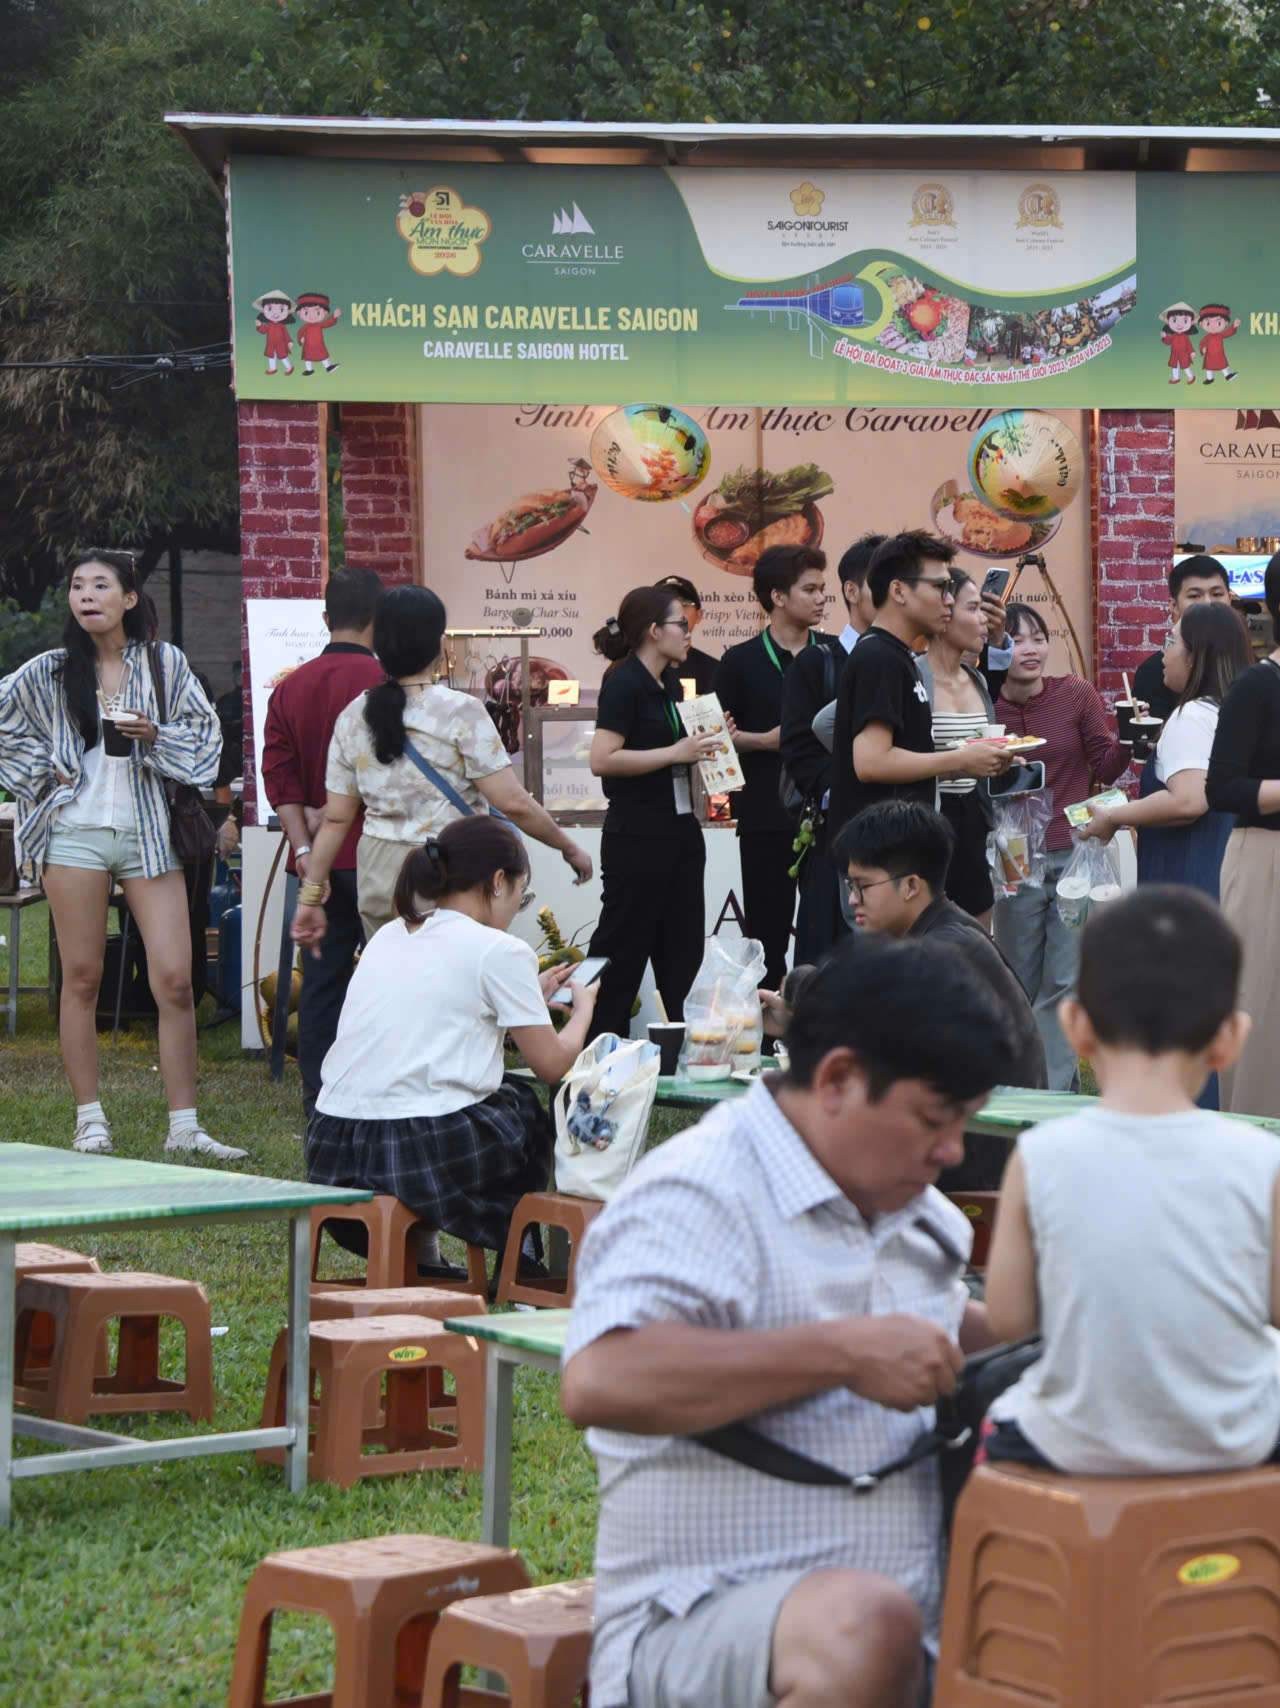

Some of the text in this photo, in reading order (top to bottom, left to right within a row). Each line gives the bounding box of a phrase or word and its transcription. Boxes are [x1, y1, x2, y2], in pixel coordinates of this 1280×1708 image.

[767, 220, 849, 231] SAIGONTOURIST
[522, 244, 624, 259] CARAVELLE
[554, 267, 596, 275] SAIGON
[351, 298, 698, 336] KHÁCH SẠN CARAVELLE SAIGON
[423, 341, 629, 360] CARAVELLE SAIGON HOTEL
[846, 345, 862, 362] HỘI
[864, 350, 876, 364] ĐÃ
[878, 355, 901, 373] ĐOẠT
[902, 362, 908, 373] 3
[910, 361, 927, 376] GIẢI
[943, 368, 963, 384] THỰC
[964, 369, 979, 385] ĐẶC
[981, 367, 995, 382] SẮC
[997, 367, 1016, 381] NHẤT
[1018, 364, 1032, 380] THẾ
[1068, 355, 1084, 368] 2024
[1084, 343, 1095, 358] VÀ
[1095, 335, 1112, 351] 2025
[760, 407, 836, 436] thực
[485, 589, 517, 600] Bánh
[557, 590, 576, 600] xíu
[700, 590, 720, 602] ánh
[724, 590, 745, 602] xèo
[531, 607, 579, 618] Char Siu
[702, 625, 724, 636] with
